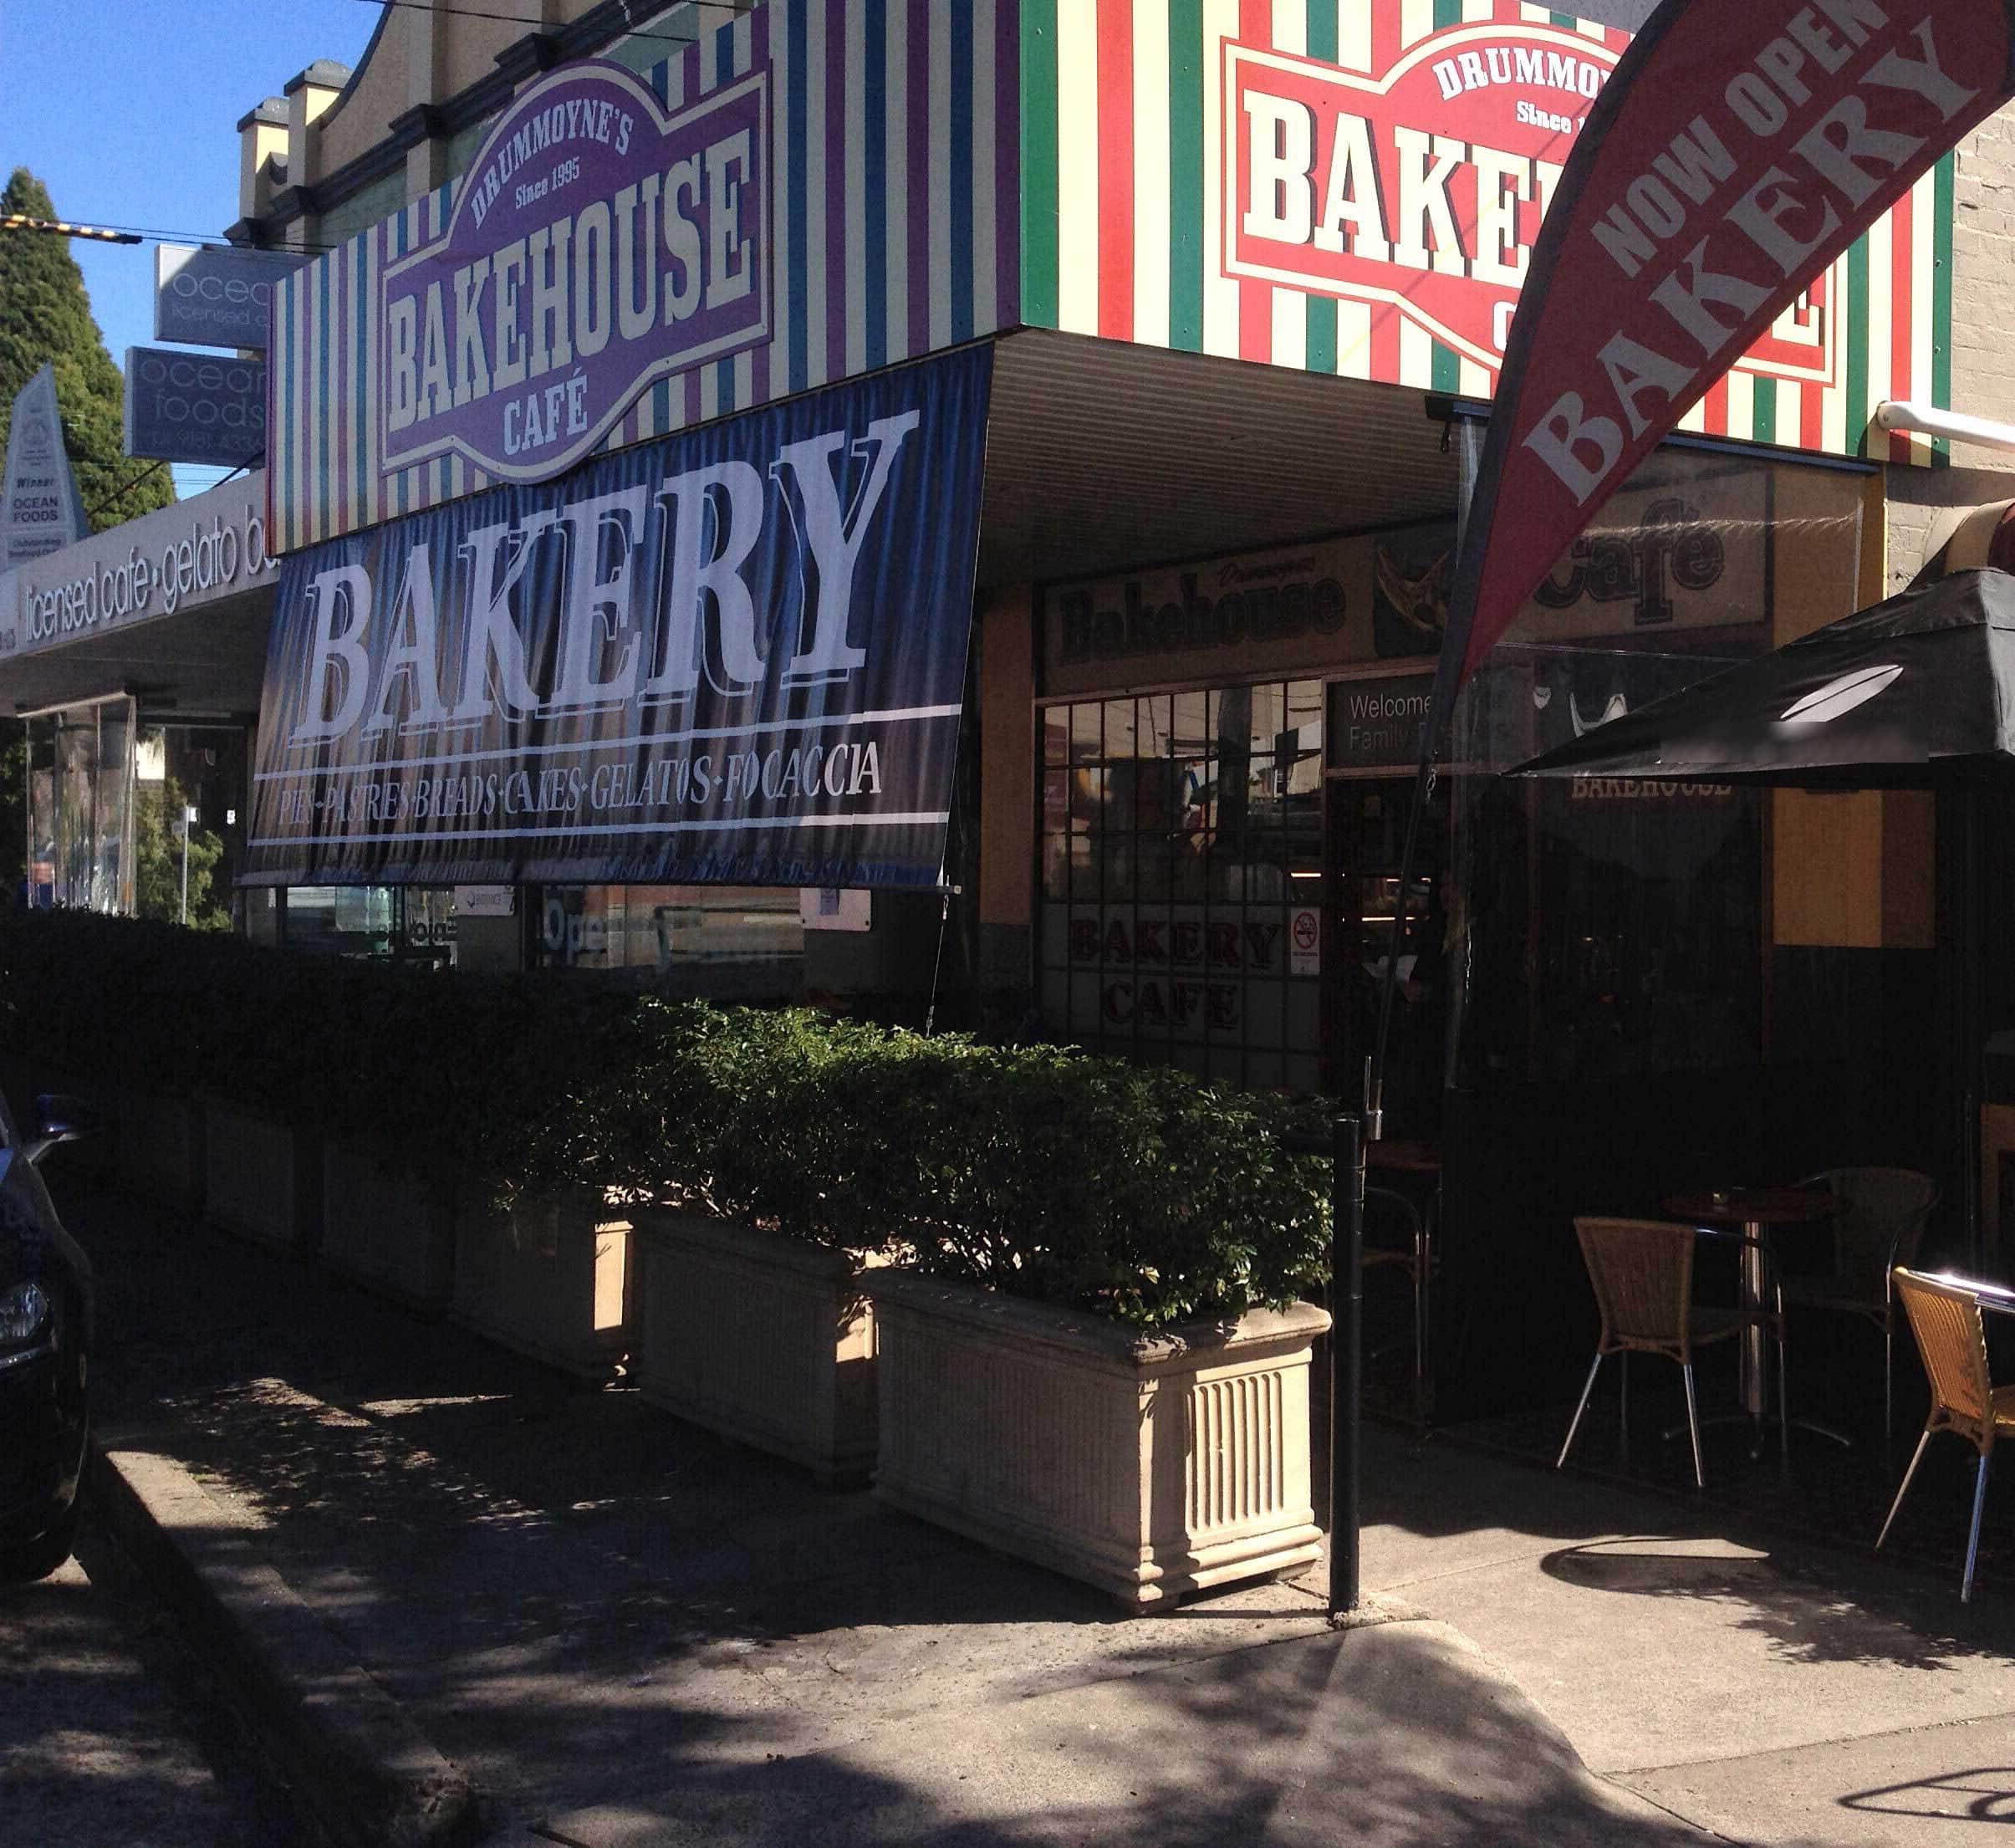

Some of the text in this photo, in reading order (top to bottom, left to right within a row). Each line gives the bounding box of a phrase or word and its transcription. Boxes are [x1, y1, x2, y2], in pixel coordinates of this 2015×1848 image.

[1517, 100, 1572, 134] Since
[1590, 0, 1890, 279] NOW OPEN
[471, 98, 634, 231] DRUMMOYNE'S
[514, 156, 580, 211] Since 1995
[388, 128, 751, 433] BAKEHOUSE
[1522, 15, 1982, 507] BAKERY
[503, 367, 588, 456] CAFÉ
[13, 498, 59, 510] OCEAN
[13, 510, 59, 523] FOODS
[17, 477, 54, 489] Winner
[26, 562, 99, 641] licensed
[101, 546, 149, 618] cafe
[161, 515, 237, 615] gelato
[288, 410, 920, 748] BAKERY
[1350, 692, 1431, 719] Welcome
[415, 773, 497, 818] BREADS
[591, 755, 712, 809] GELATOS
[723, 741, 882, 802] FOCACCIA
[1070, 920, 1282, 969] BAKERY
